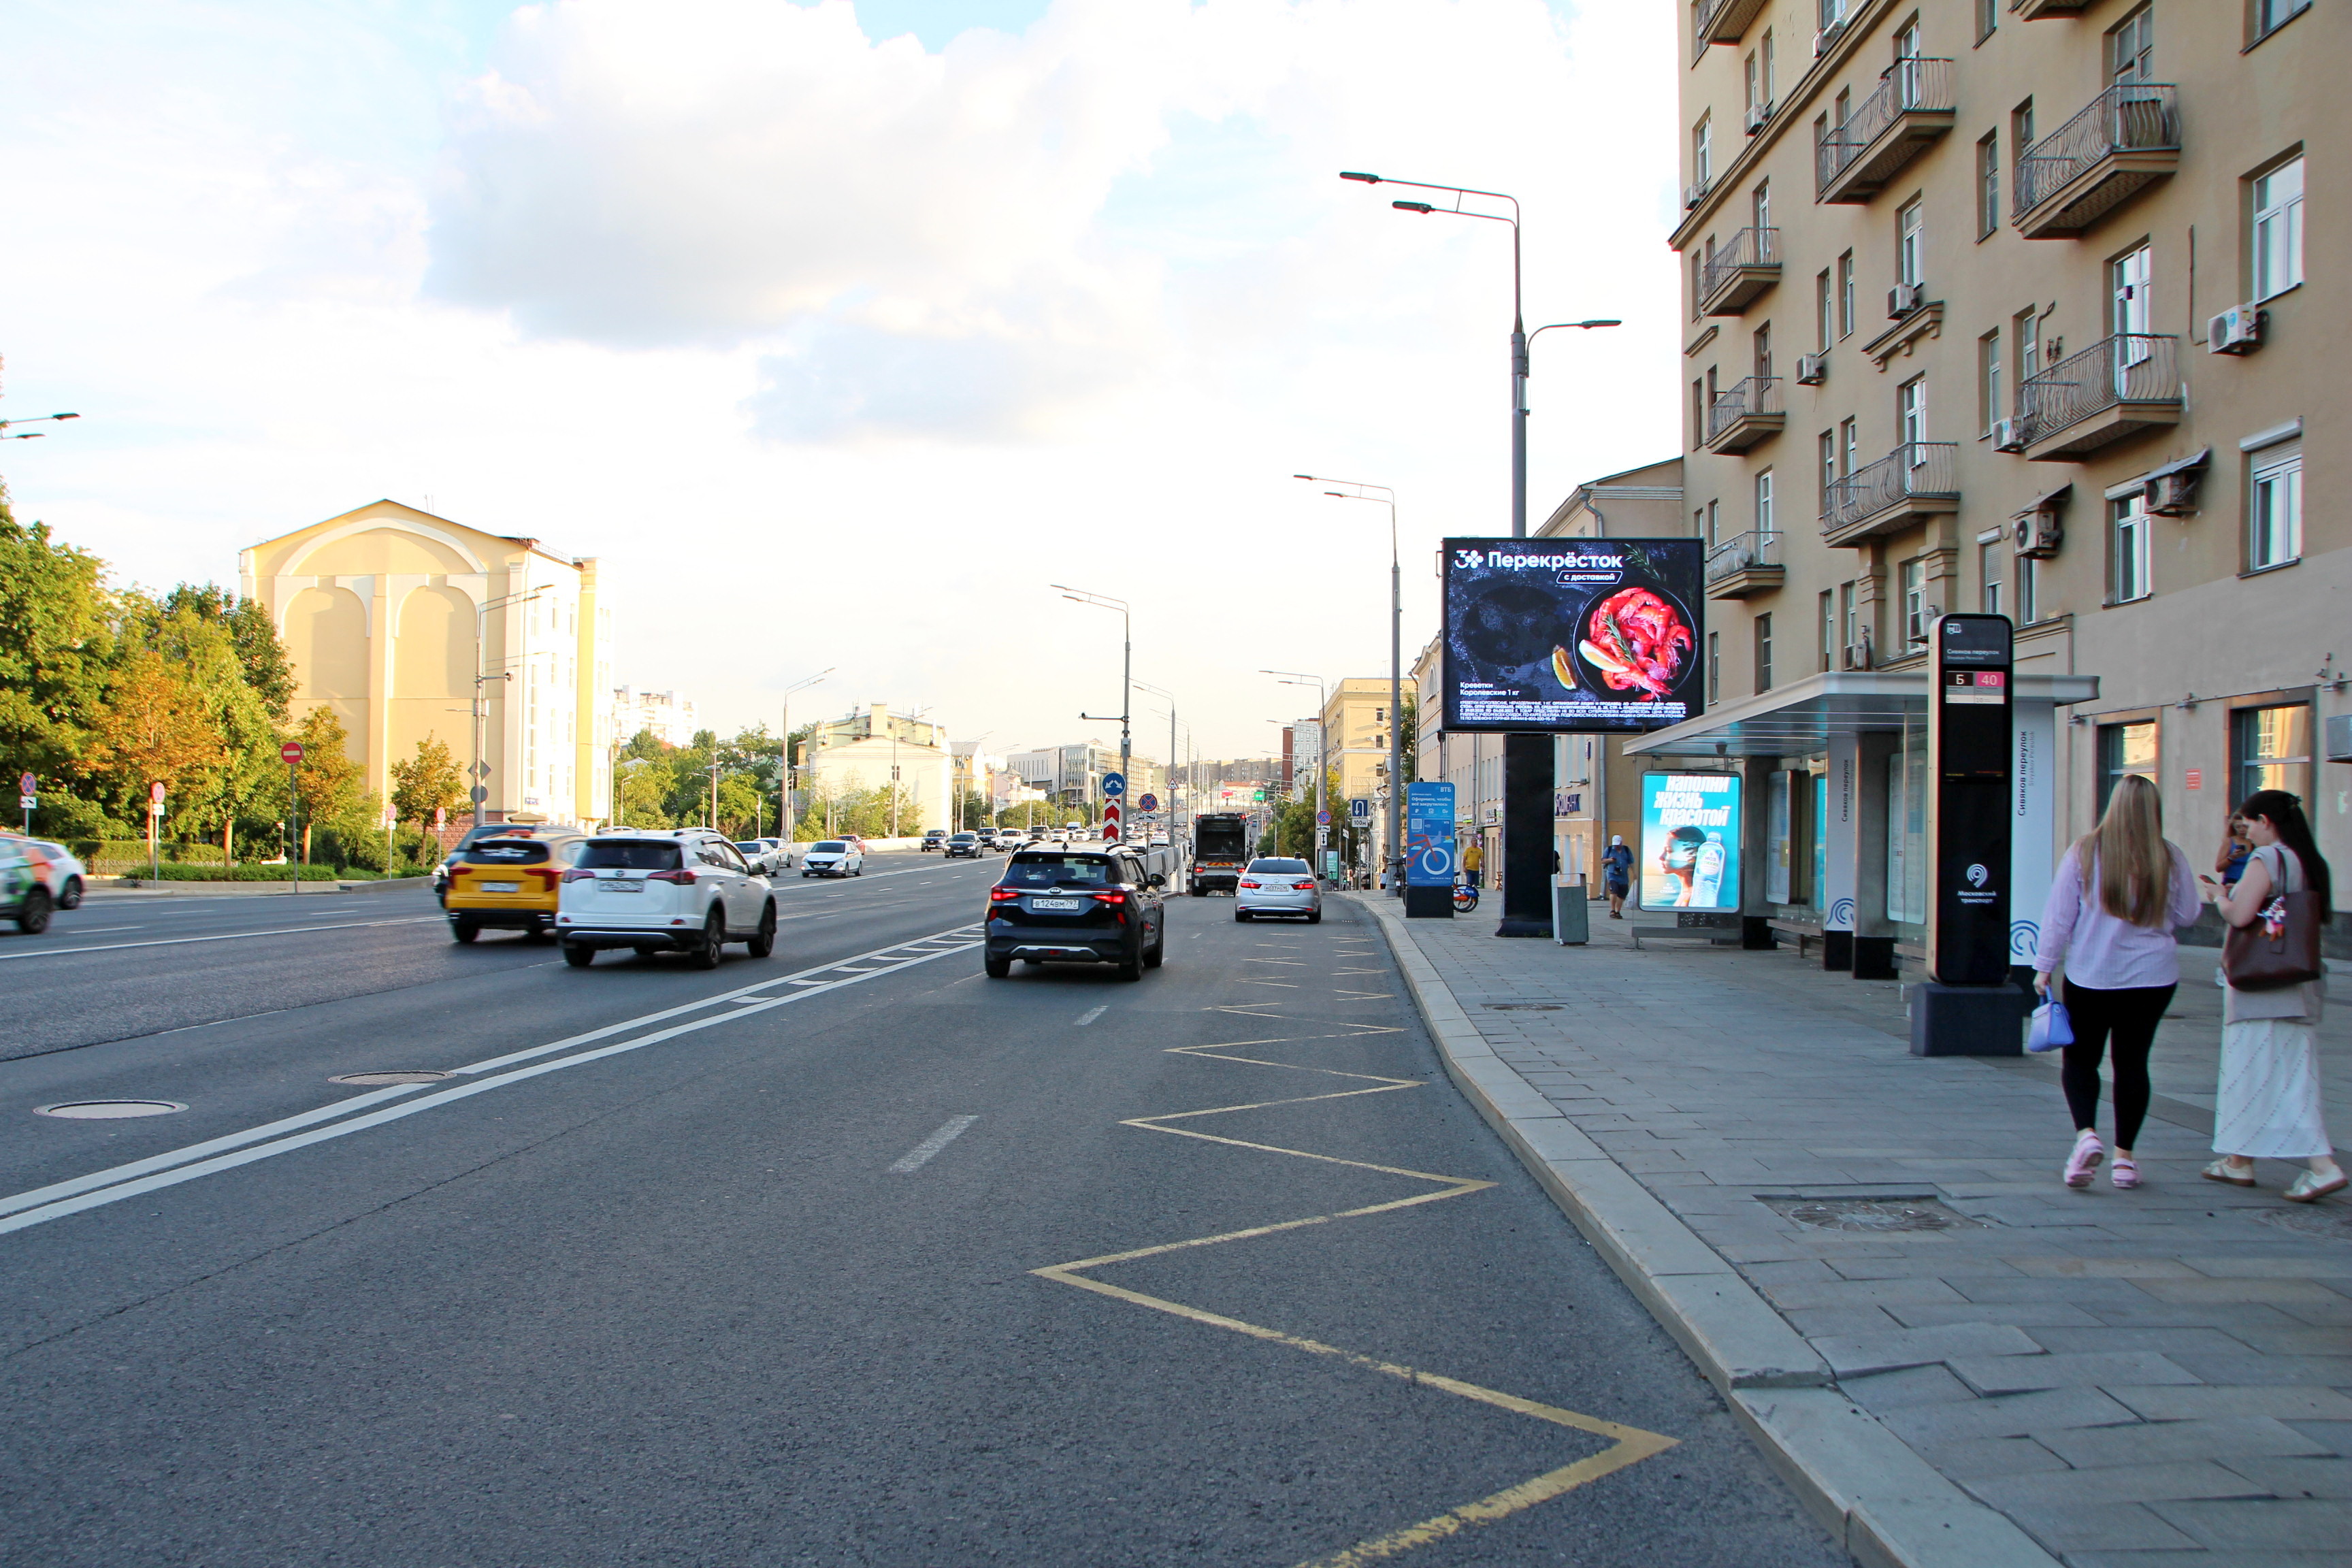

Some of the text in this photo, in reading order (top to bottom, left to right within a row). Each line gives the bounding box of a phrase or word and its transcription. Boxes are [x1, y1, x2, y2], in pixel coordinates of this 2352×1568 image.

[1488, 551, 1623, 572] Перекрёсток
[1571, 573, 1615, 581] доставкой
[1981, 675, 1997, 685] 40
